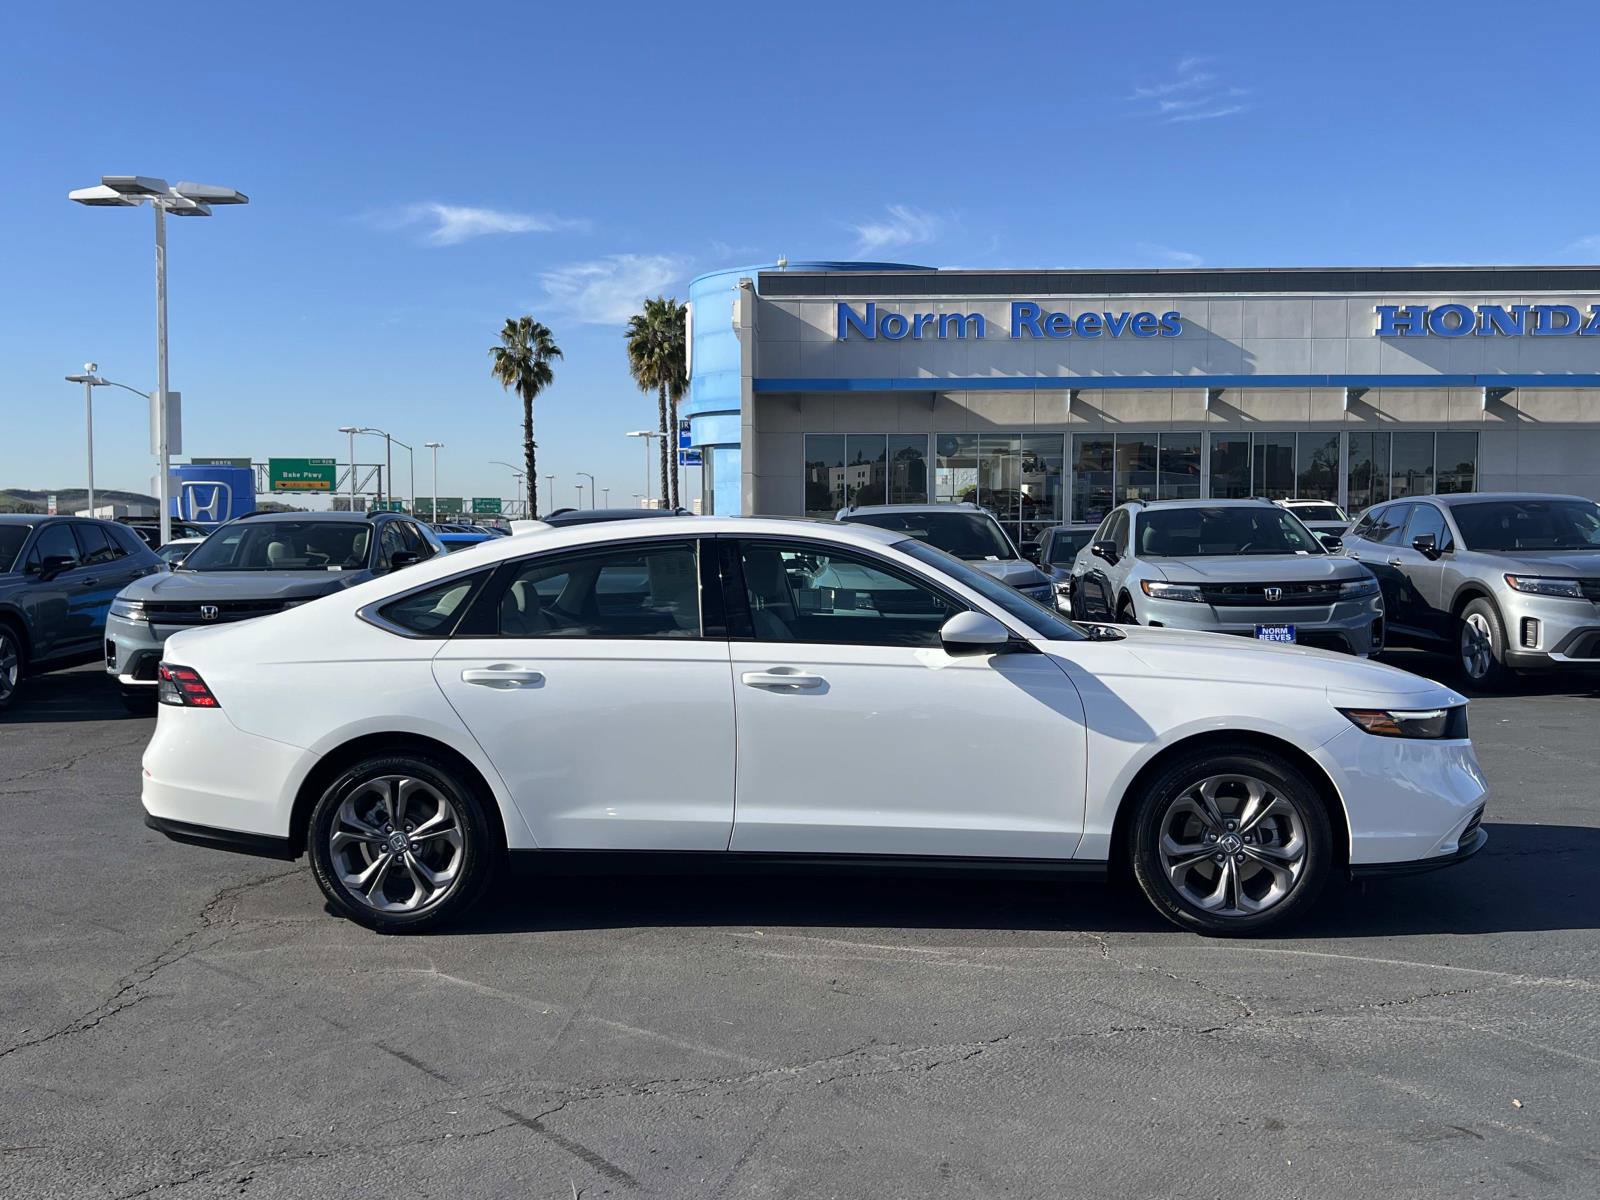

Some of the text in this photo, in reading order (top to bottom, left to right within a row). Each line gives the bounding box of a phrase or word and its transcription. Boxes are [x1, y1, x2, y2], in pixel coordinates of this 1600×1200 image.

[837, 301, 1184, 339] Norm Reeves
[282, 471, 322, 480] Bake Pkwy
